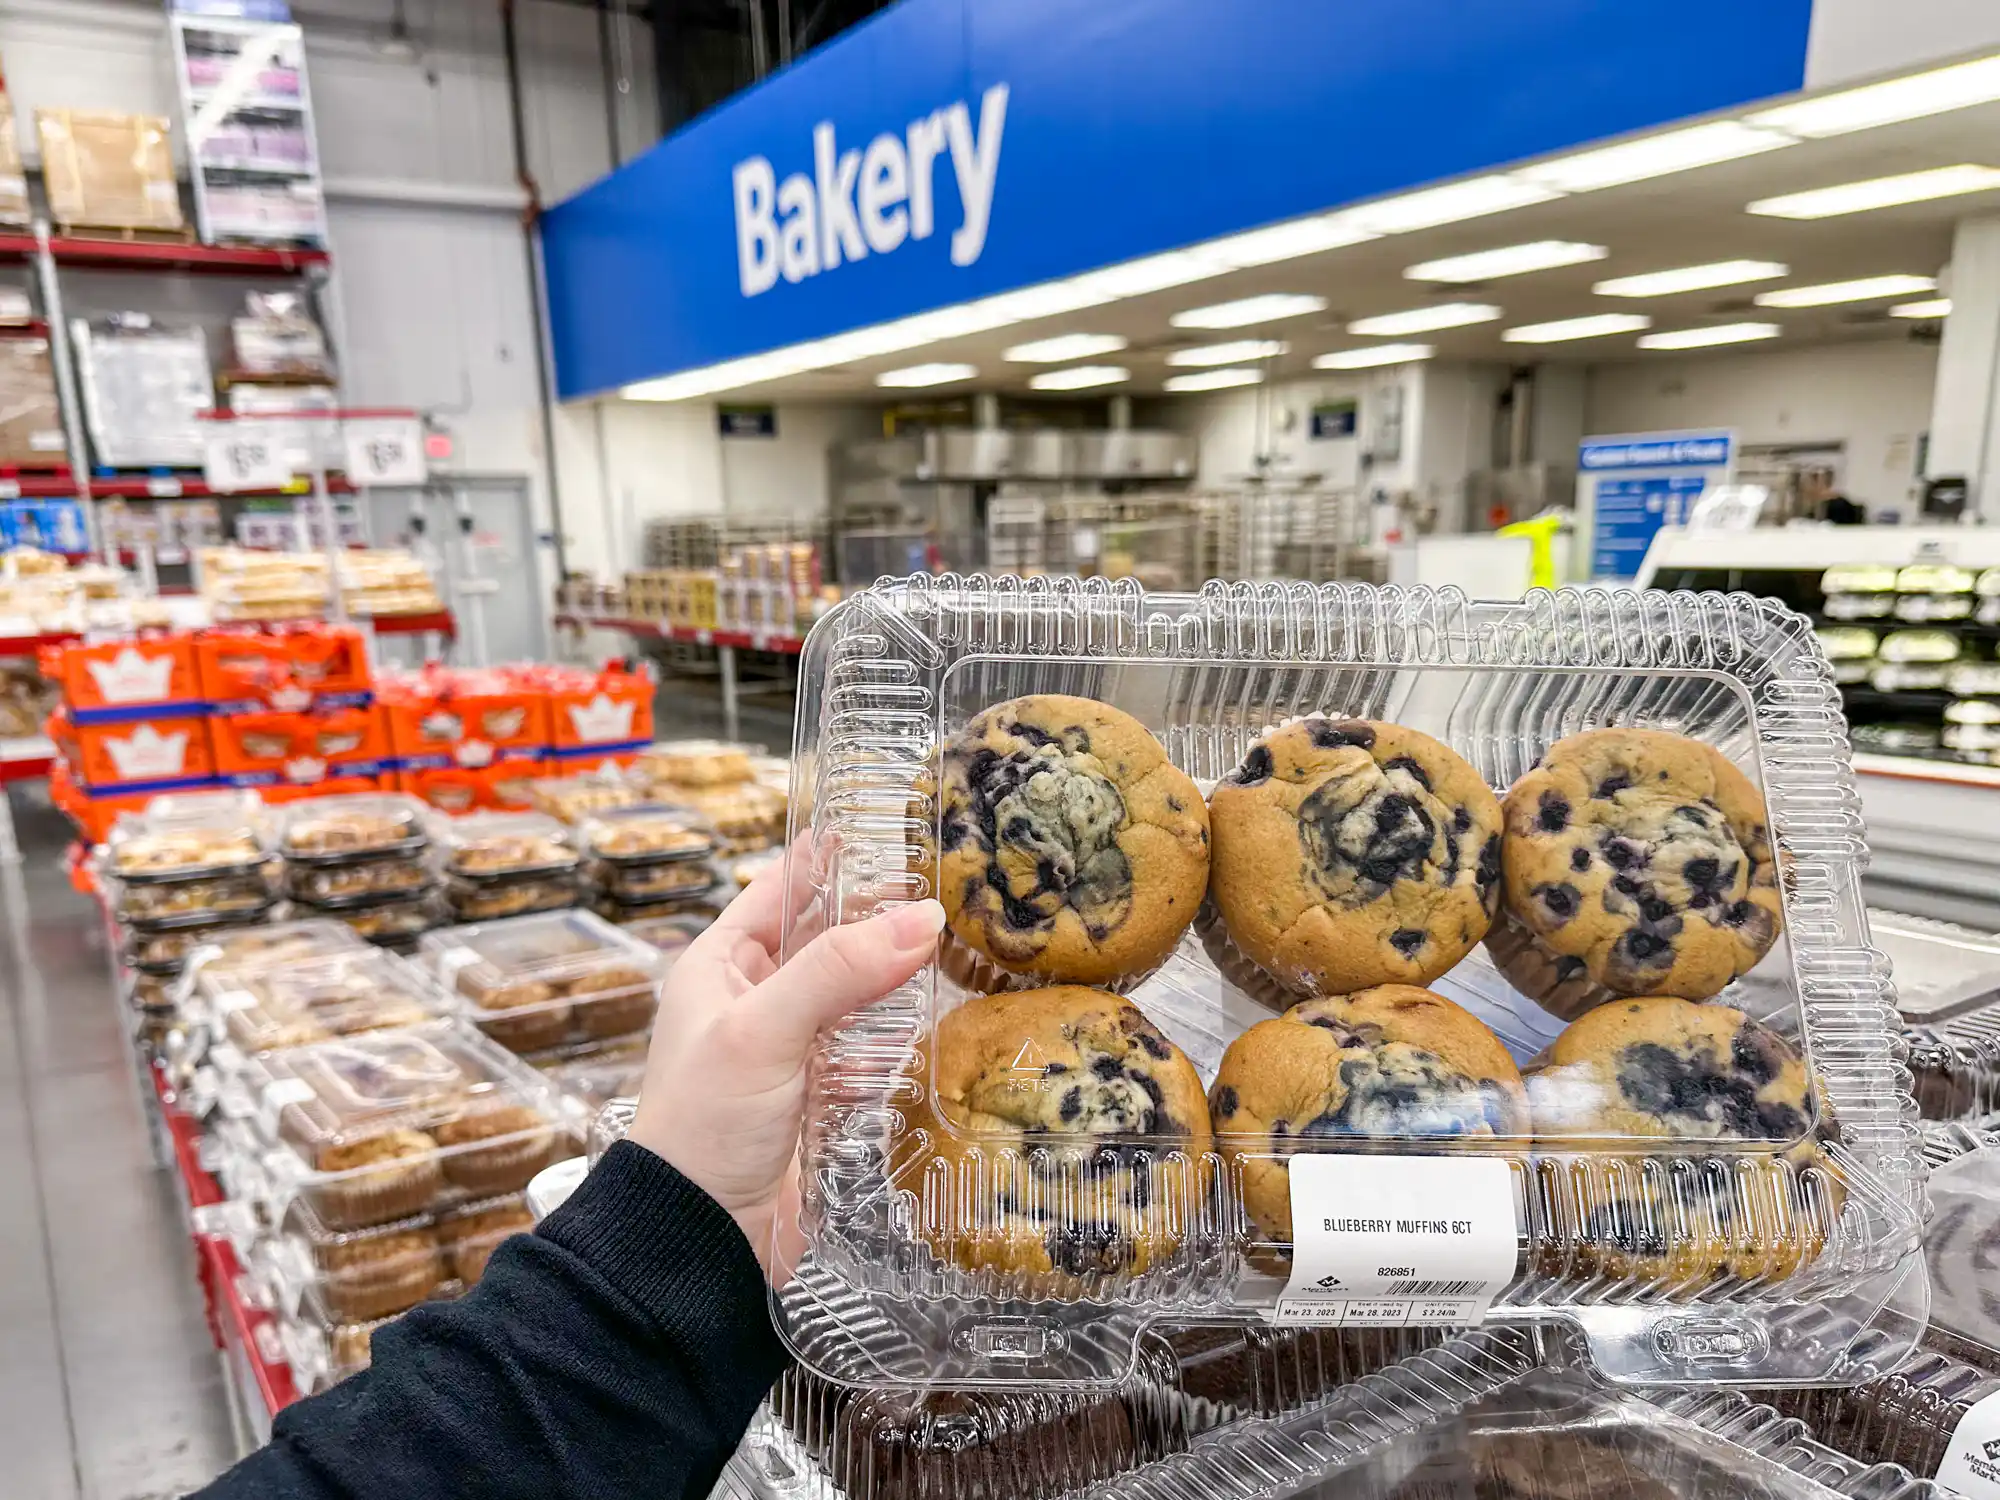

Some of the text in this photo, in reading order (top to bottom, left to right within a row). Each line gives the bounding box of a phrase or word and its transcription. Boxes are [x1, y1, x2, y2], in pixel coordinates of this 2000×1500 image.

[732, 81, 1009, 298] Bakery
[1323, 1218, 1472, 1234] BLUEBERRY MUFFINS 6CT
[1377, 1267, 1416, 1276] 826851
[1284, 1308, 1299, 1316] Mar
[1315, 1308, 1336, 1317] 2023
[1349, 1309, 1364, 1317] Mar
[1381, 1309, 1401, 1317] 2023
[1969, 1464, 1996, 1482] Mark
